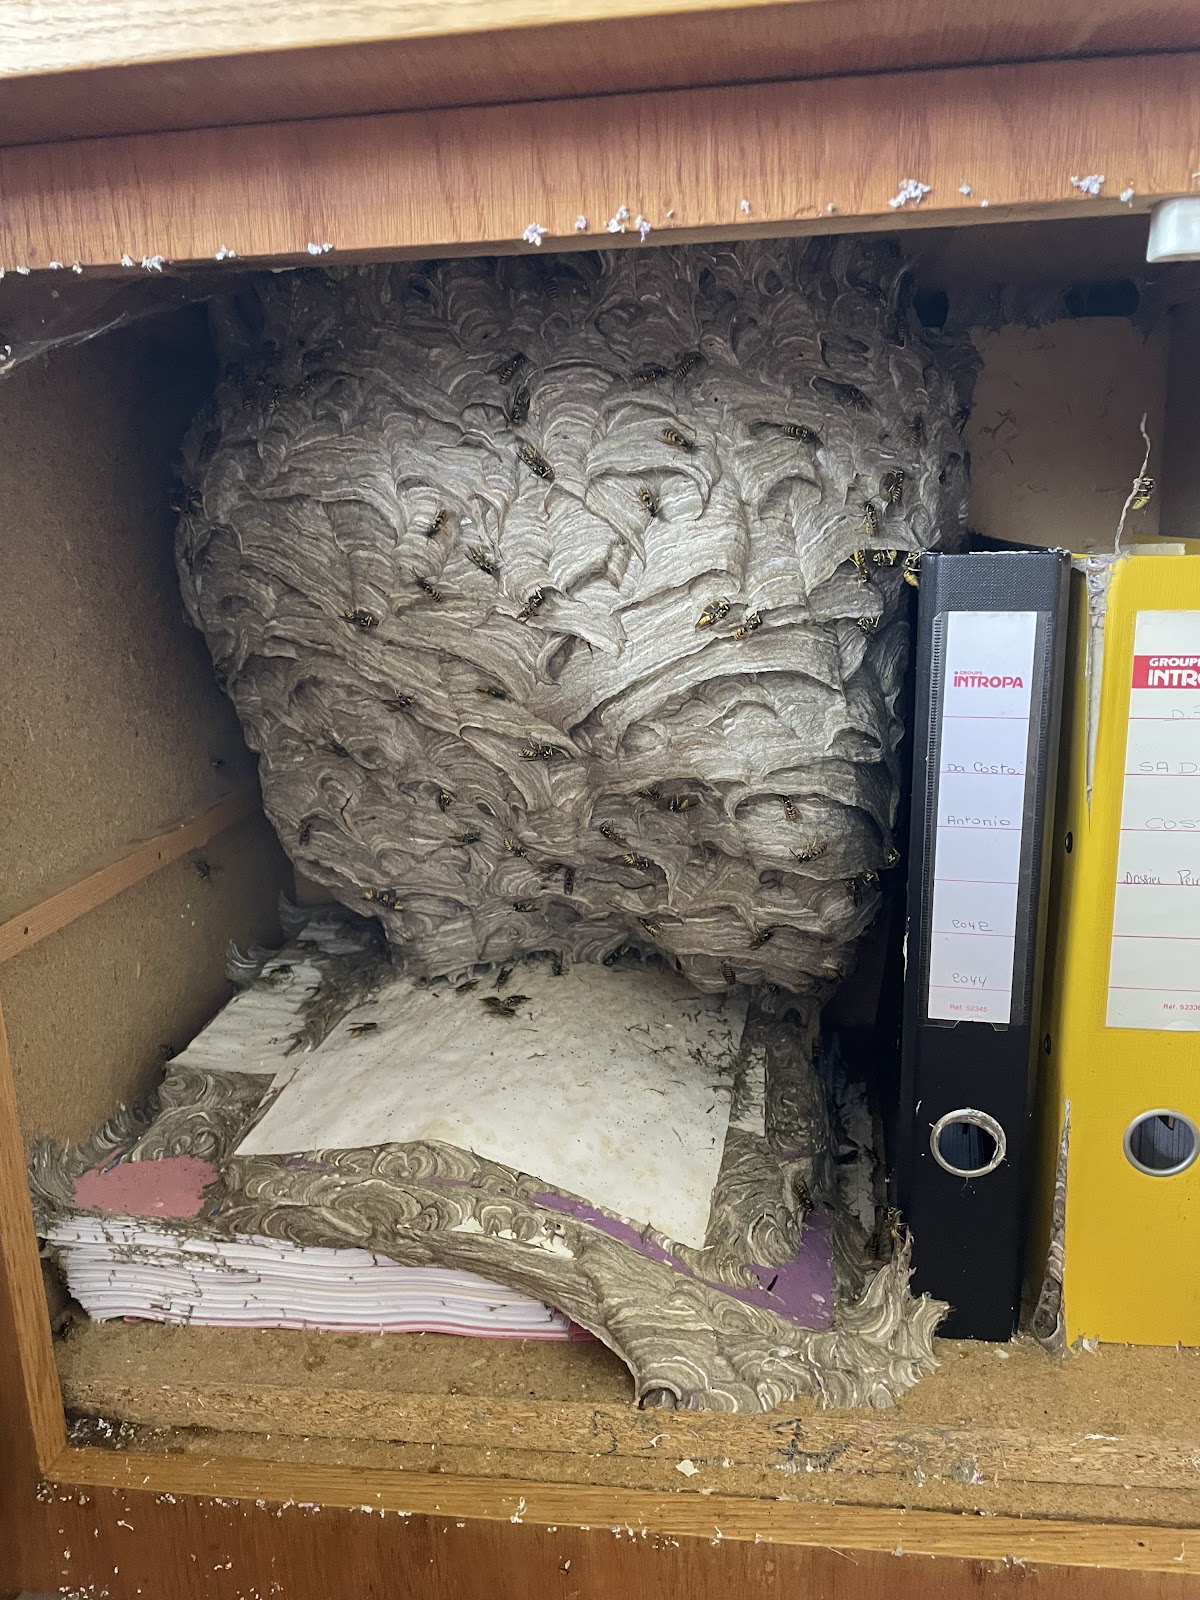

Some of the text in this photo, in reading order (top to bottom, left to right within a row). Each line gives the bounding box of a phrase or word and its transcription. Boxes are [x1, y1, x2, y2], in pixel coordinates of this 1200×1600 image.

[953, 672, 1024, 689] INTROPA
[1147, 669, 1200, 687] INTR
[947, 815, 1011, 828] Antonio
[966, 1004, 988, 1013] 52345
